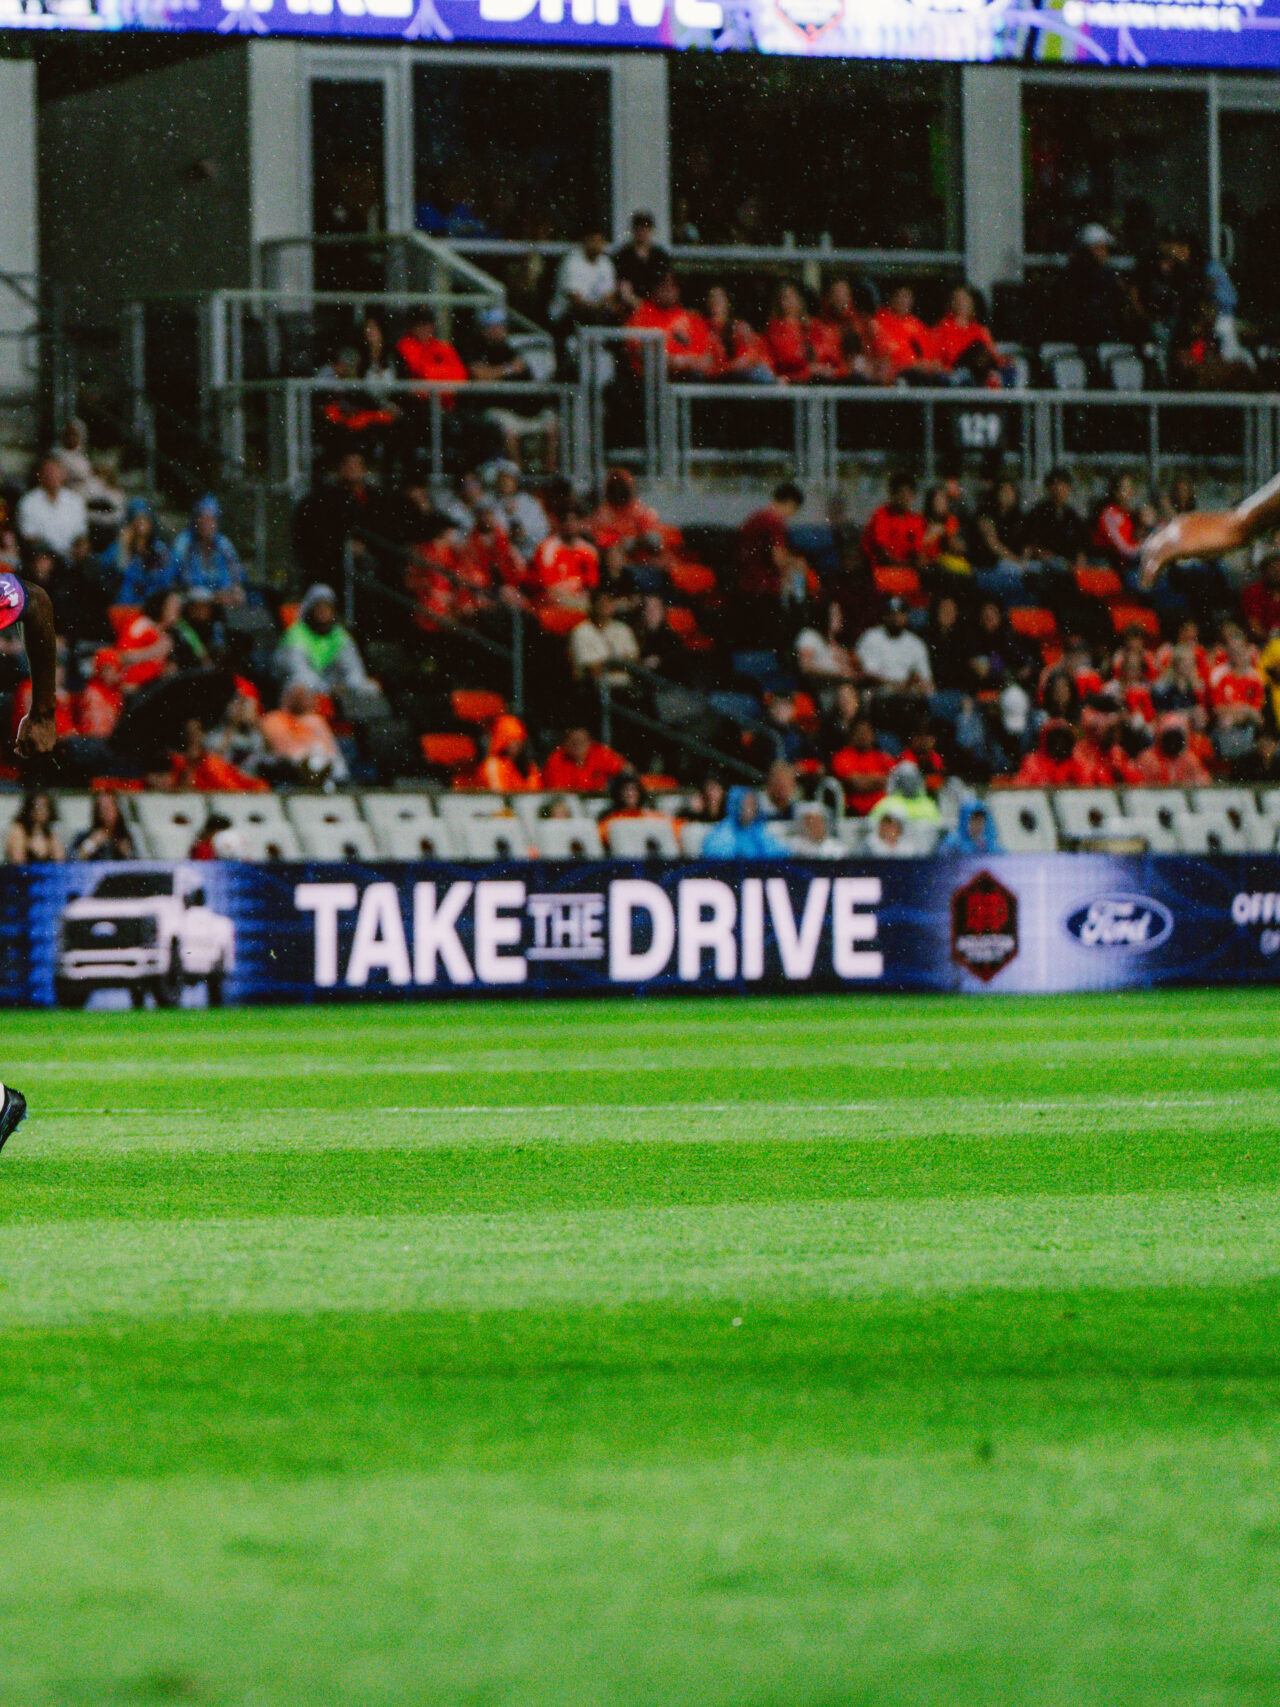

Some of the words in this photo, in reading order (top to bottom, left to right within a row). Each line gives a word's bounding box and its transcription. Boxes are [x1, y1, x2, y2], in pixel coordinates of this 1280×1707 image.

[294, 880, 528, 986] TAKE
[527, 901, 605, 949] THE
[608, 877, 884, 982] DRIVE
[1081, 901, 1151, 947] Ford
